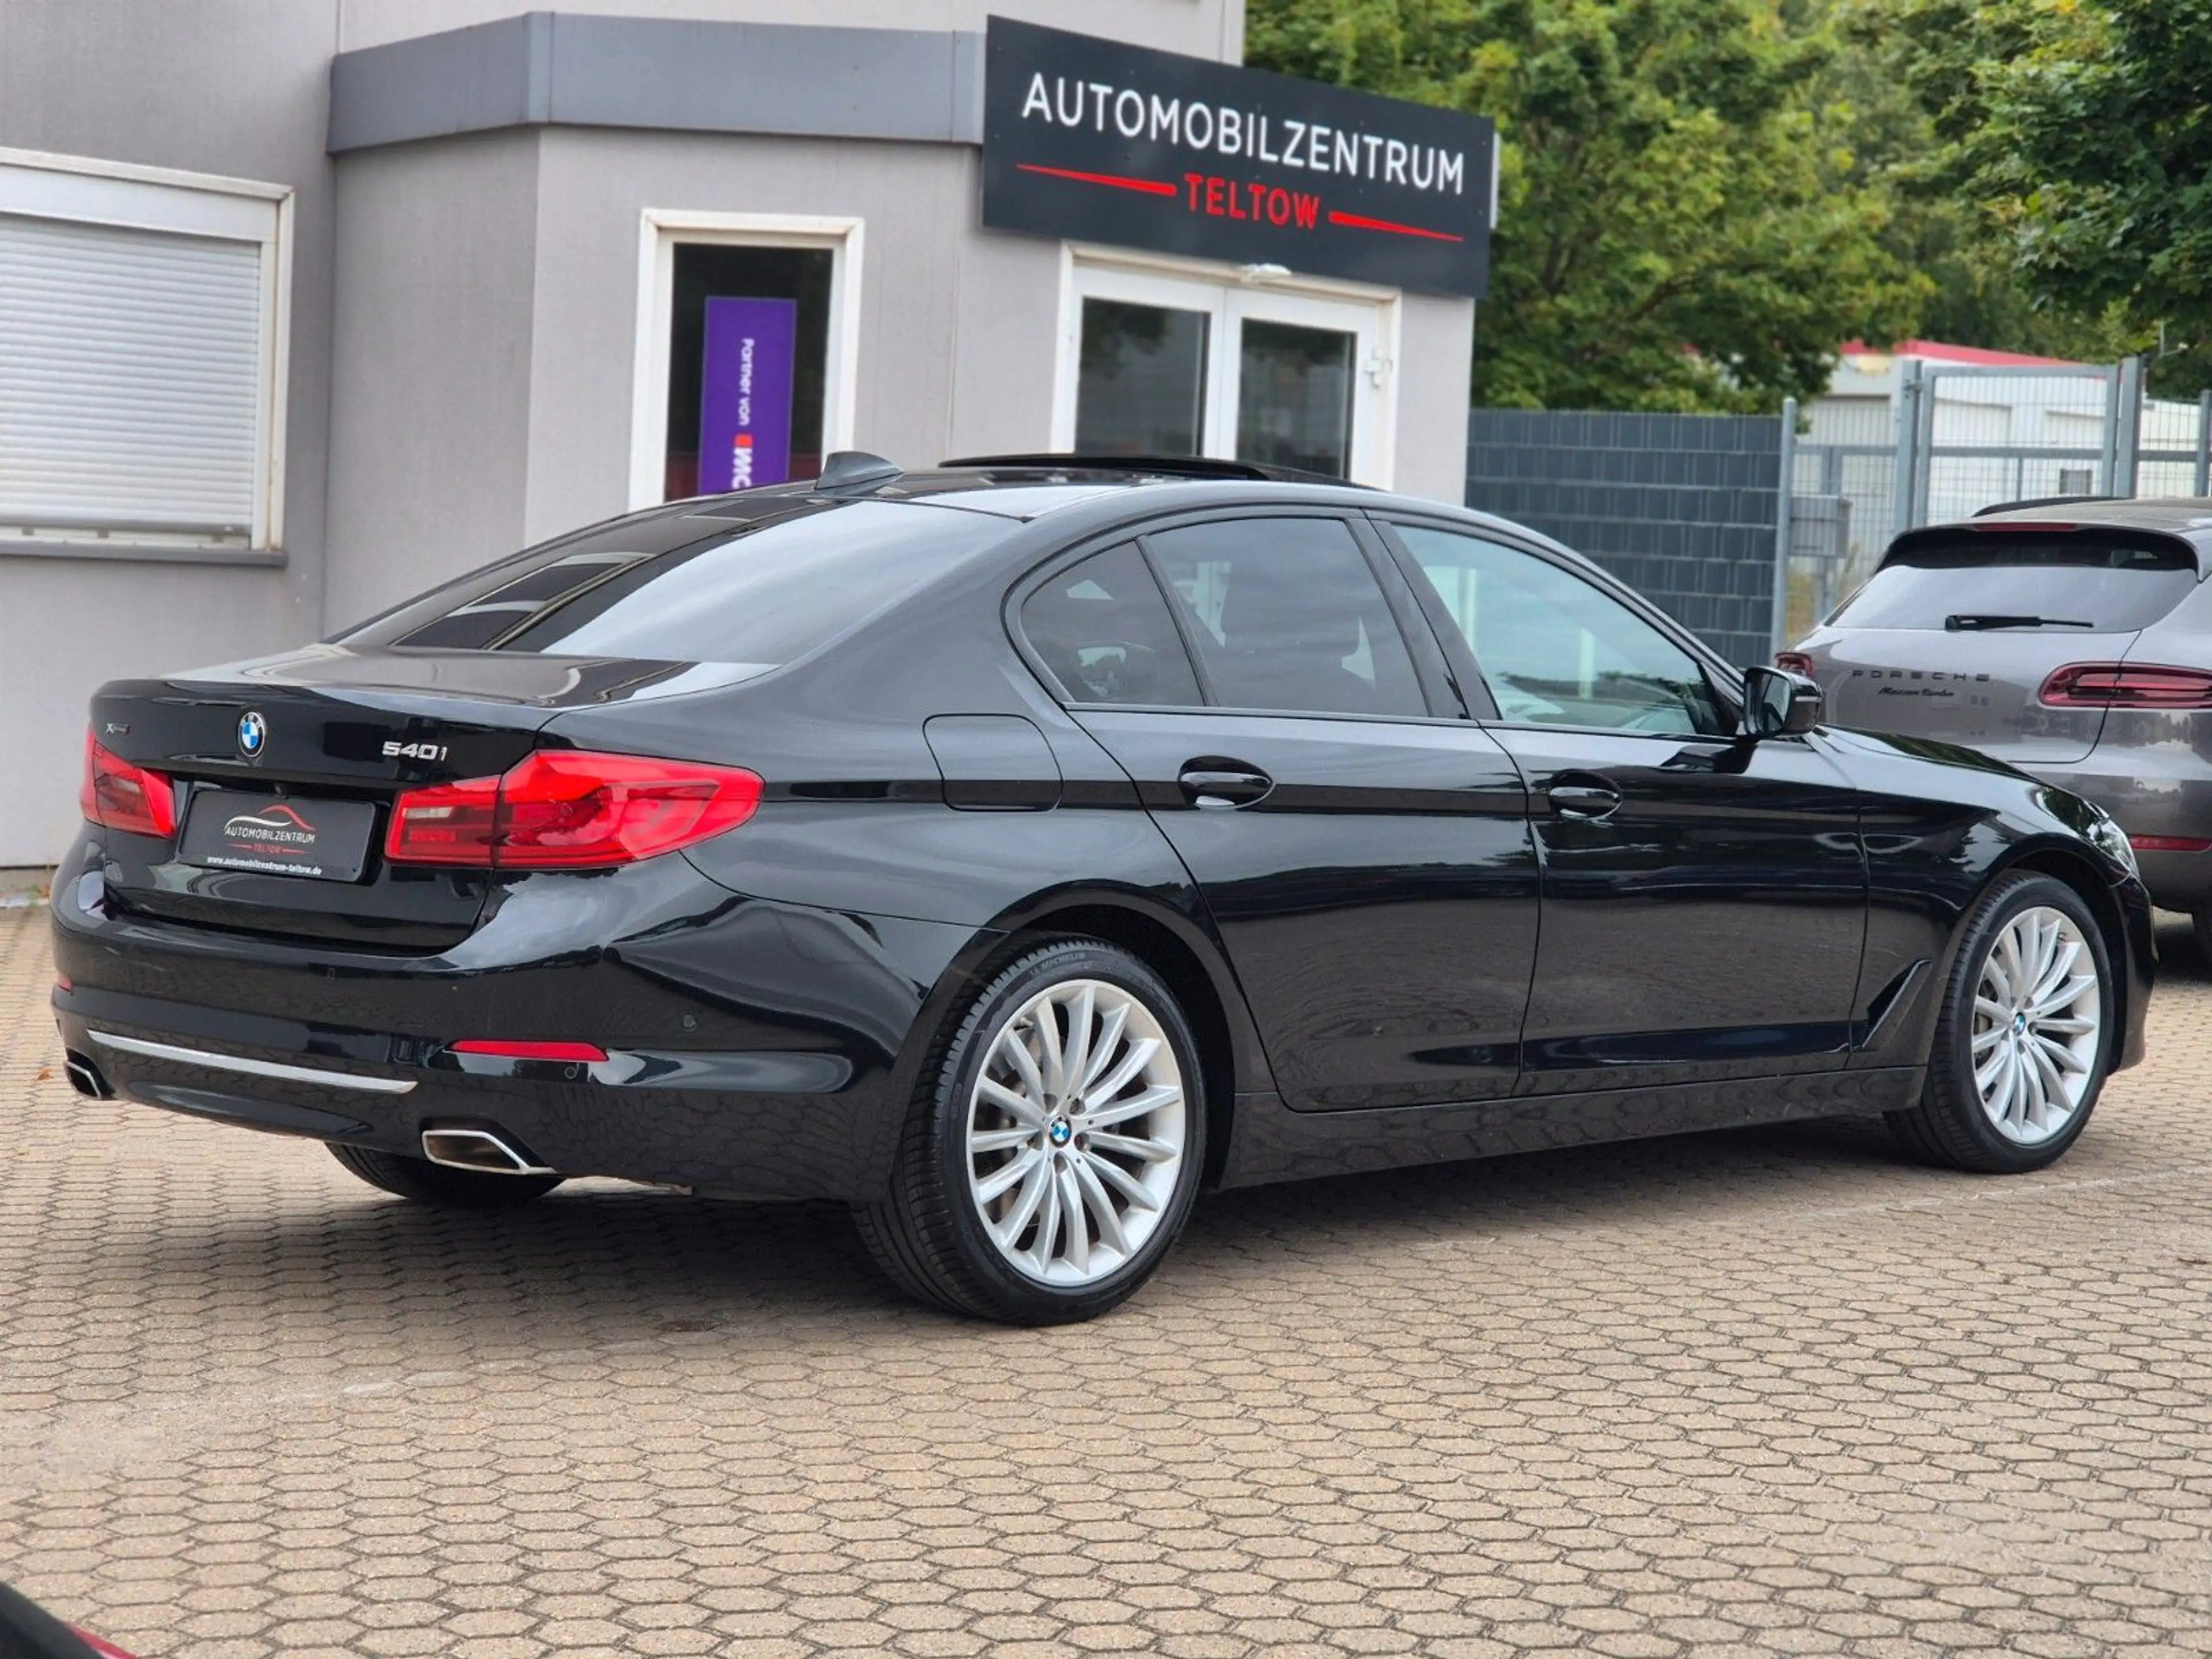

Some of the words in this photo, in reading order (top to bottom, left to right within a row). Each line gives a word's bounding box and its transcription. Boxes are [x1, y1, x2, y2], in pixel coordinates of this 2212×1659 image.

[1022, 73, 1464, 195] AUTOMOBILZENTRUM
[1184, 173, 1320, 229] TELTOW
[740, 338, 755, 394] Partner
[738, 397, 751, 426] von
[1852, 670, 1990, 682] PORSCHE
[382, 741, 448, 761] 540i
[225, 827, 316, 843] AUTOMOBILZENTRUM
